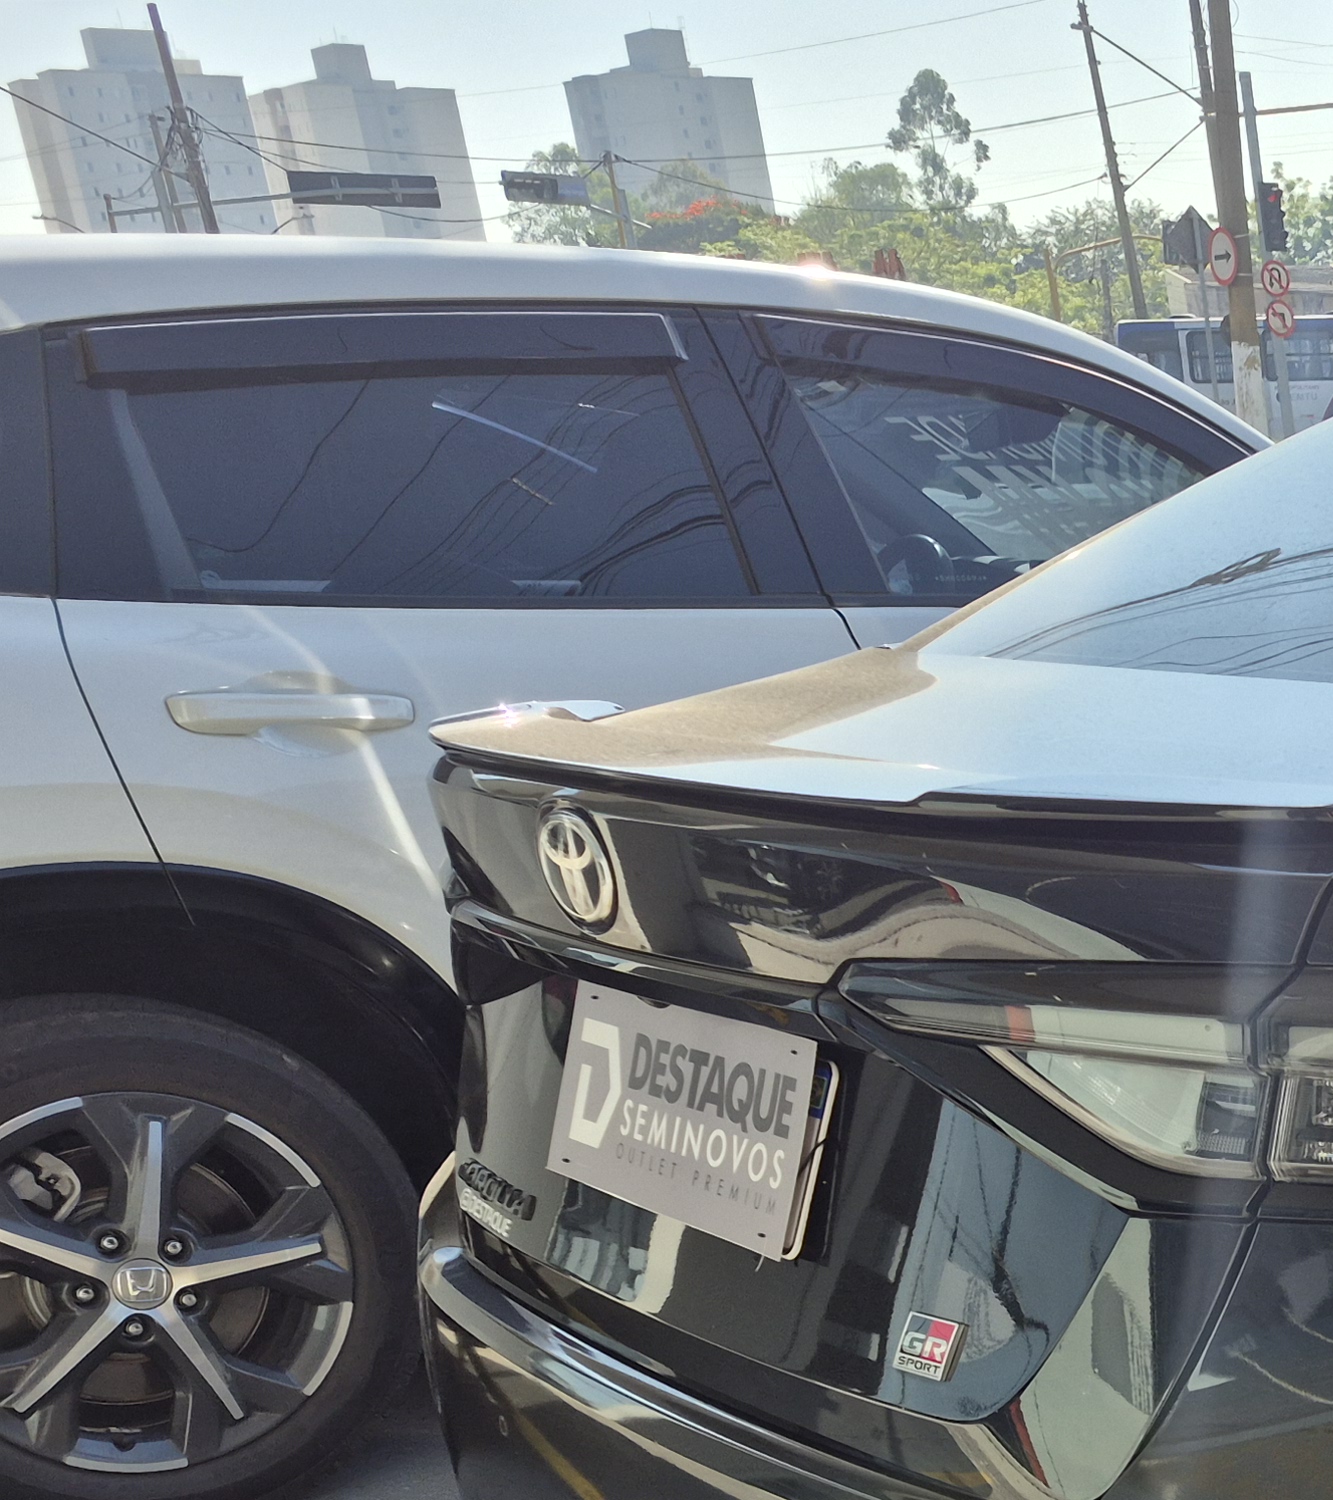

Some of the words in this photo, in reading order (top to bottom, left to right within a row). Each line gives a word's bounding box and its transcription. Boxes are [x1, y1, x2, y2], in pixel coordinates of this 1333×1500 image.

[628, 1032, 797, 1139] DESTAQUE
[615, 1142, 678, 1179] OUTLET
[691, 1169, 777, 1215] PREMIUM
[620, 1098, 785, 1189] SEMINOVOS
[897, 1355, 941, 1375] SPORT
[902, 1331, 948, 1363] GR
